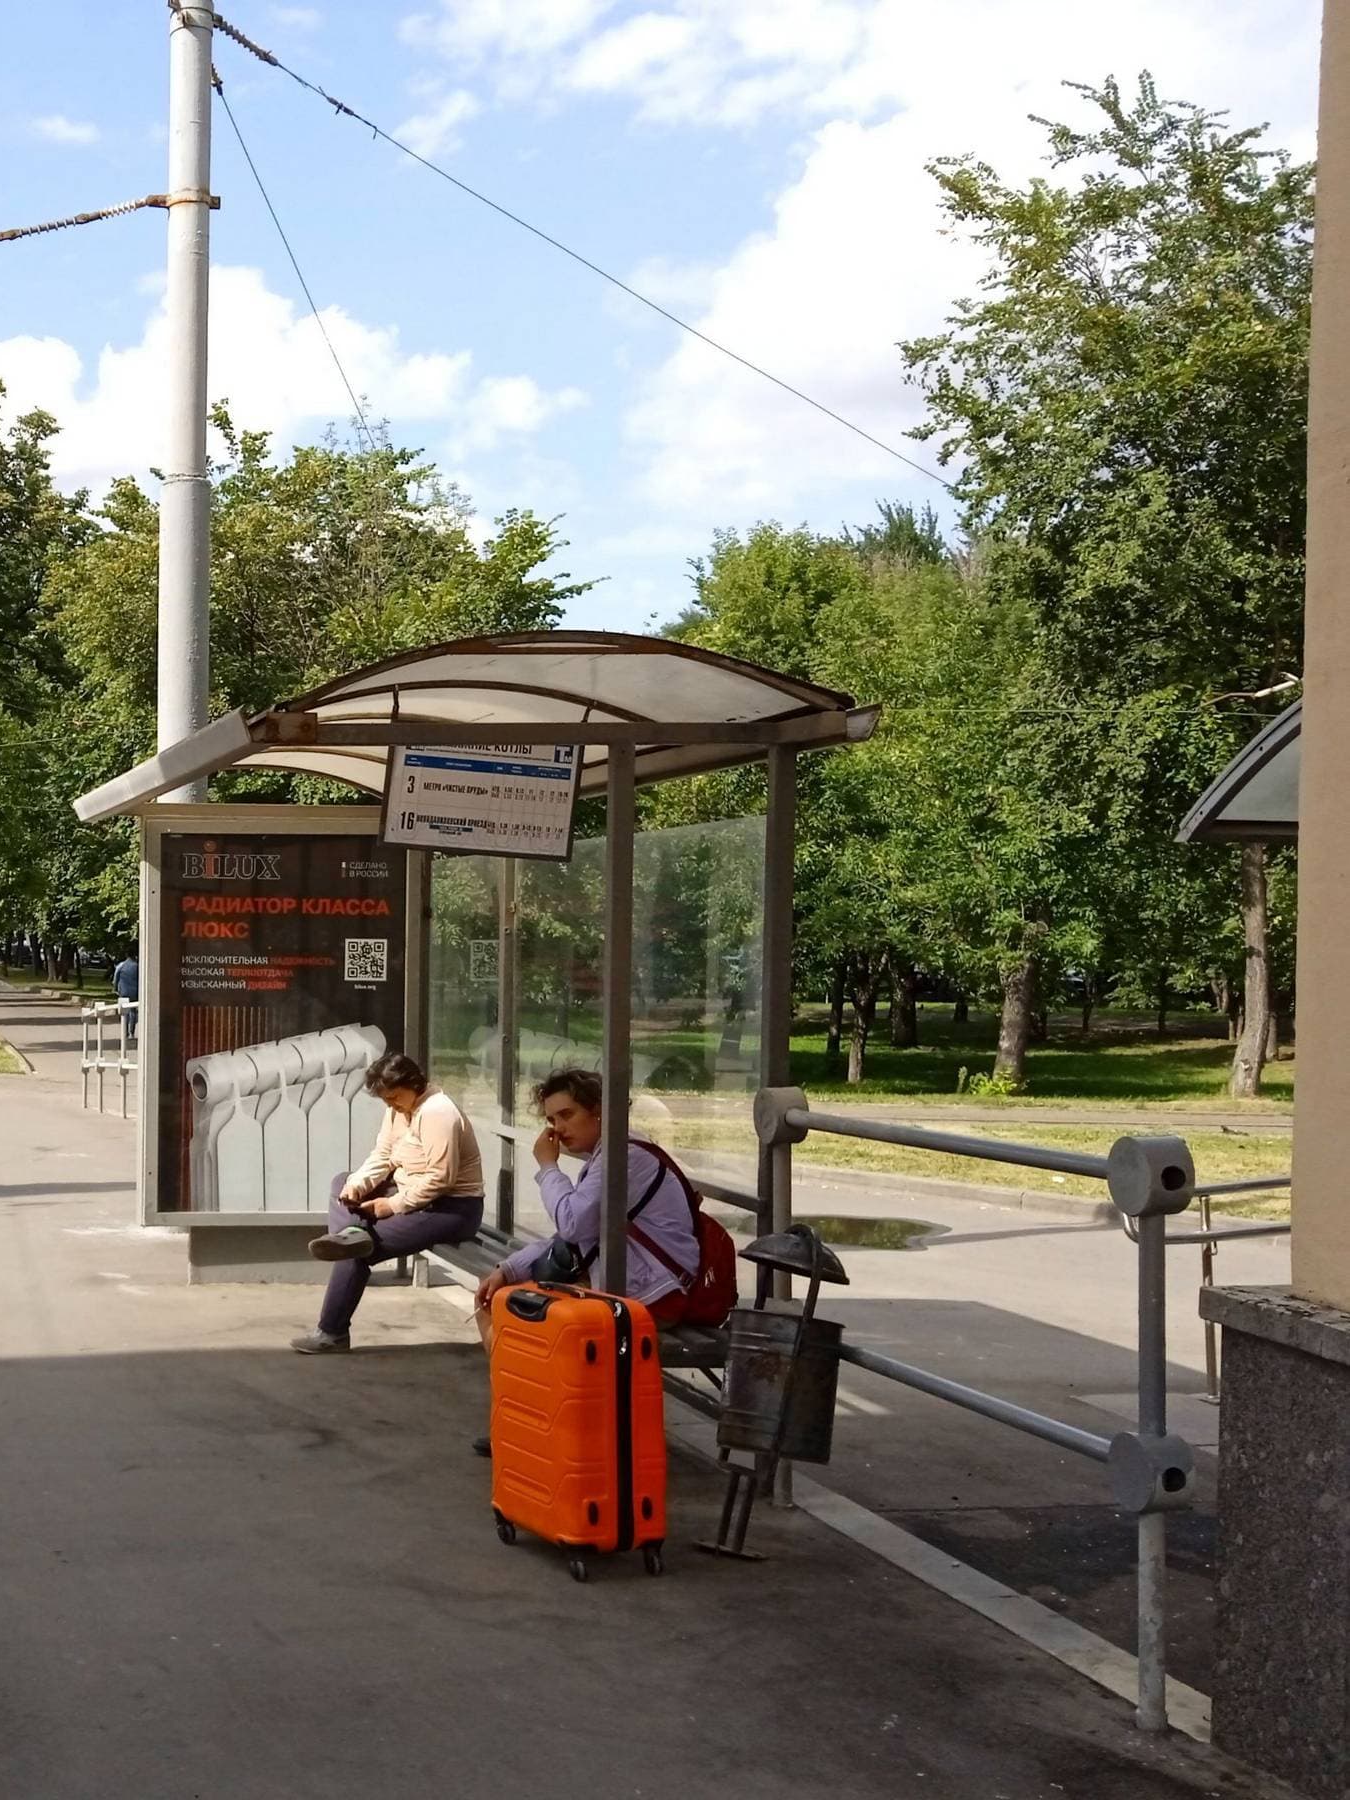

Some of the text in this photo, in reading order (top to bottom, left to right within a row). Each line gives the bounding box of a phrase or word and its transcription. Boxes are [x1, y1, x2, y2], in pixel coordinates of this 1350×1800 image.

[407, 775, 415, 794] 3
[400, 811, 415, 830] 16
[349, 861, 387, 870] СДЕЛАНО
[349, 870, 388, 878] В РОССИИ
[181, 896, 389, 915] РАДИАТОР КЛАССА
[181, 921, 249, 938] ЛЮКС
[181, 955, 268, 965] ИСКЛЮЧИТЕЛЬНАЯ
[181, 968, 225, 976] ВЫСОКАЯ
[181, 980, 246, 990] ИЗЫСКАННЫЙ
